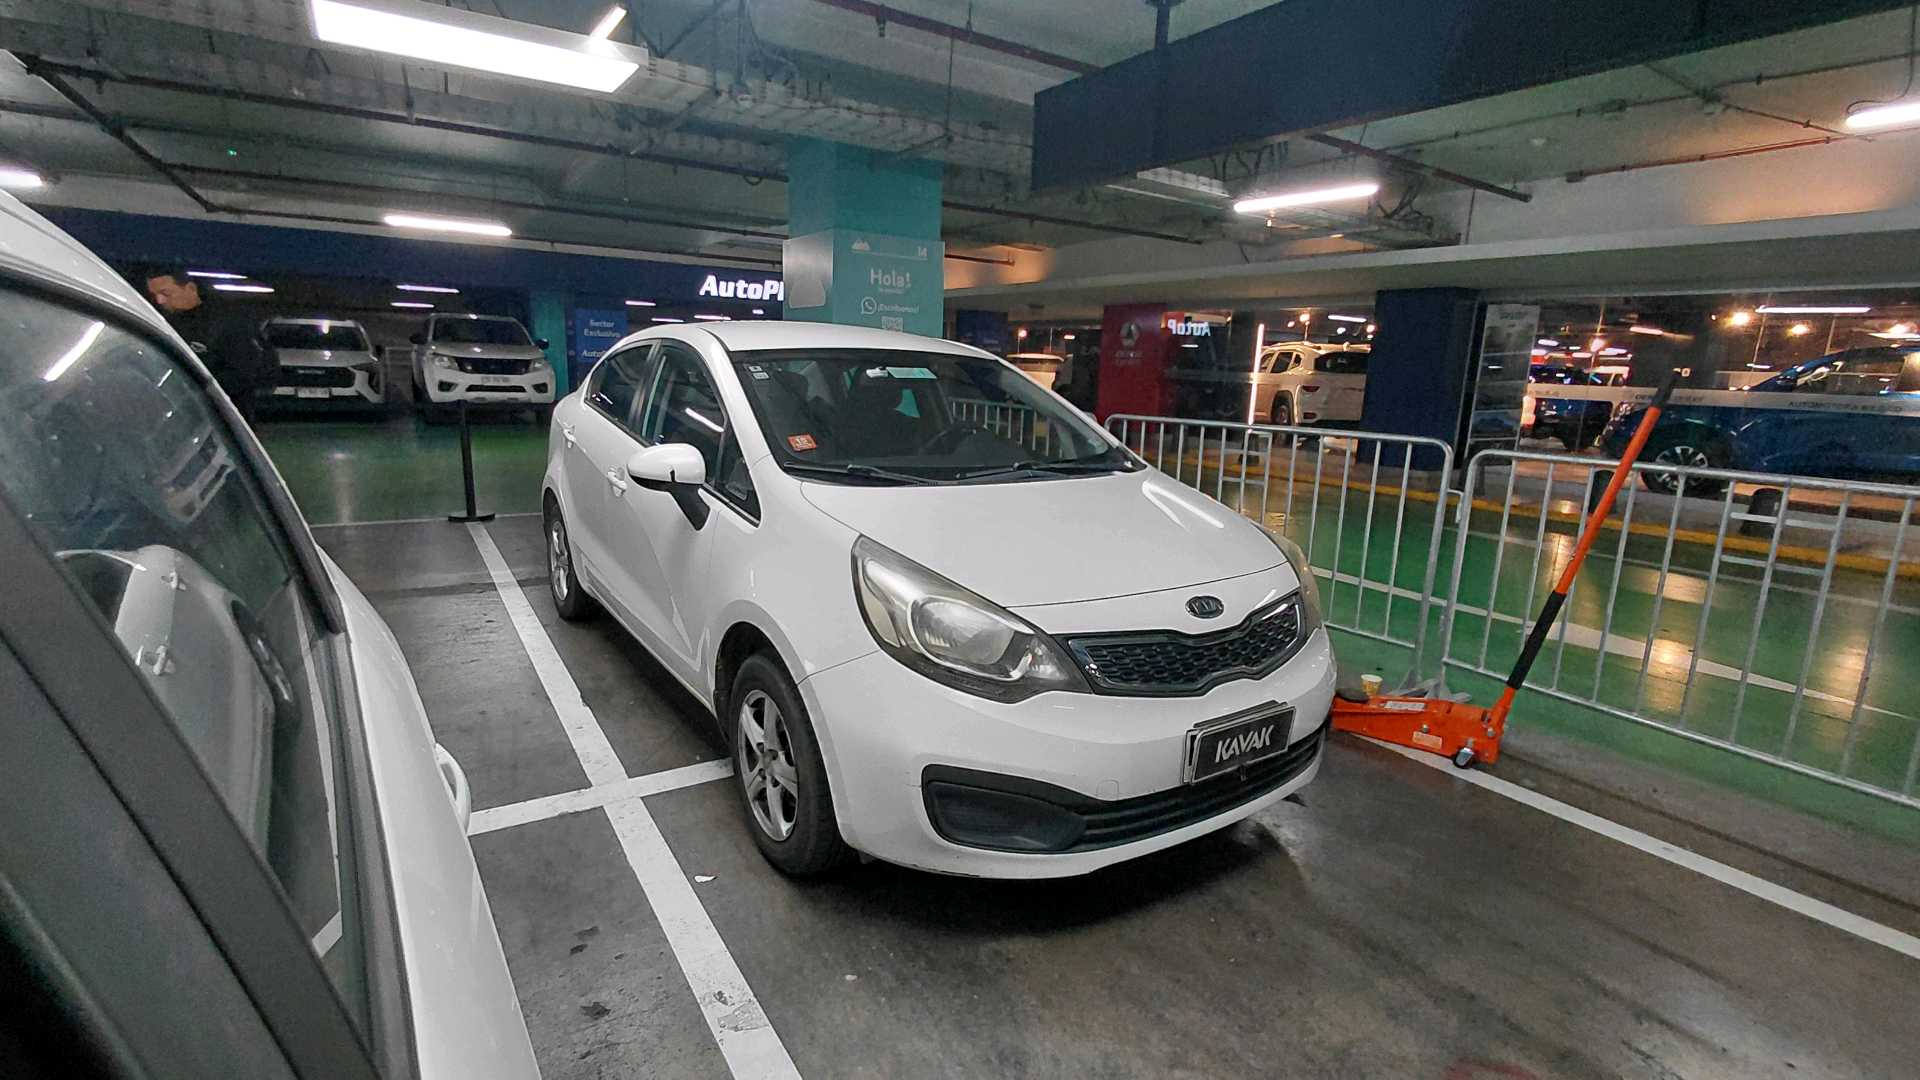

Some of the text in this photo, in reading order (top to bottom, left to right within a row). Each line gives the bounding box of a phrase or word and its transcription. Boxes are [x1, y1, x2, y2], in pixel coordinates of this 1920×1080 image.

[870, 267, 912, 289] Hola!
[589, 320, 615, 328] Sector
[1215, 724, 1274, 763] KAVAK
